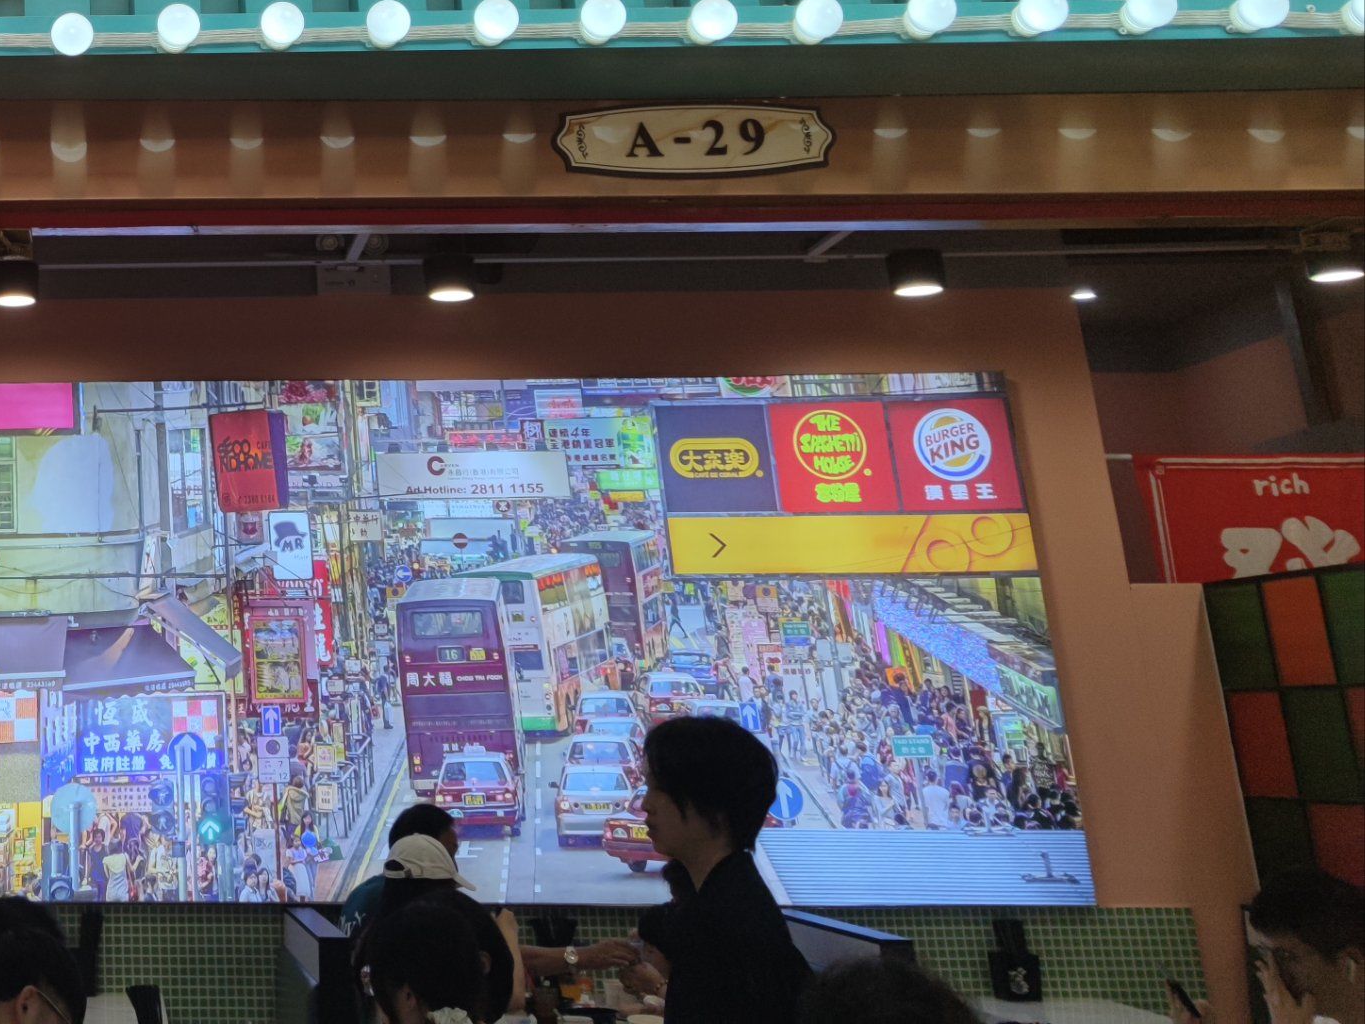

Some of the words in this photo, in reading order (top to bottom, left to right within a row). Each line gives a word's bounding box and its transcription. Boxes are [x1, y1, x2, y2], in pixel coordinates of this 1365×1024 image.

[625, 117, 767, 158] A-29
[924, 422, 975, 447] BURGER
[929, 434, 981, 464] KING
[423, 485, 468, 495] Hotline:
[470, 483, 505, 495] 2811
[510, 483, 544, 494] 1155
[1252, 472, 1311, 497] rich
[281, 539, 305, 553] MR
[406, 671, 454, 688] 周大福
[83, 729, 166, 755] 中西藥房
